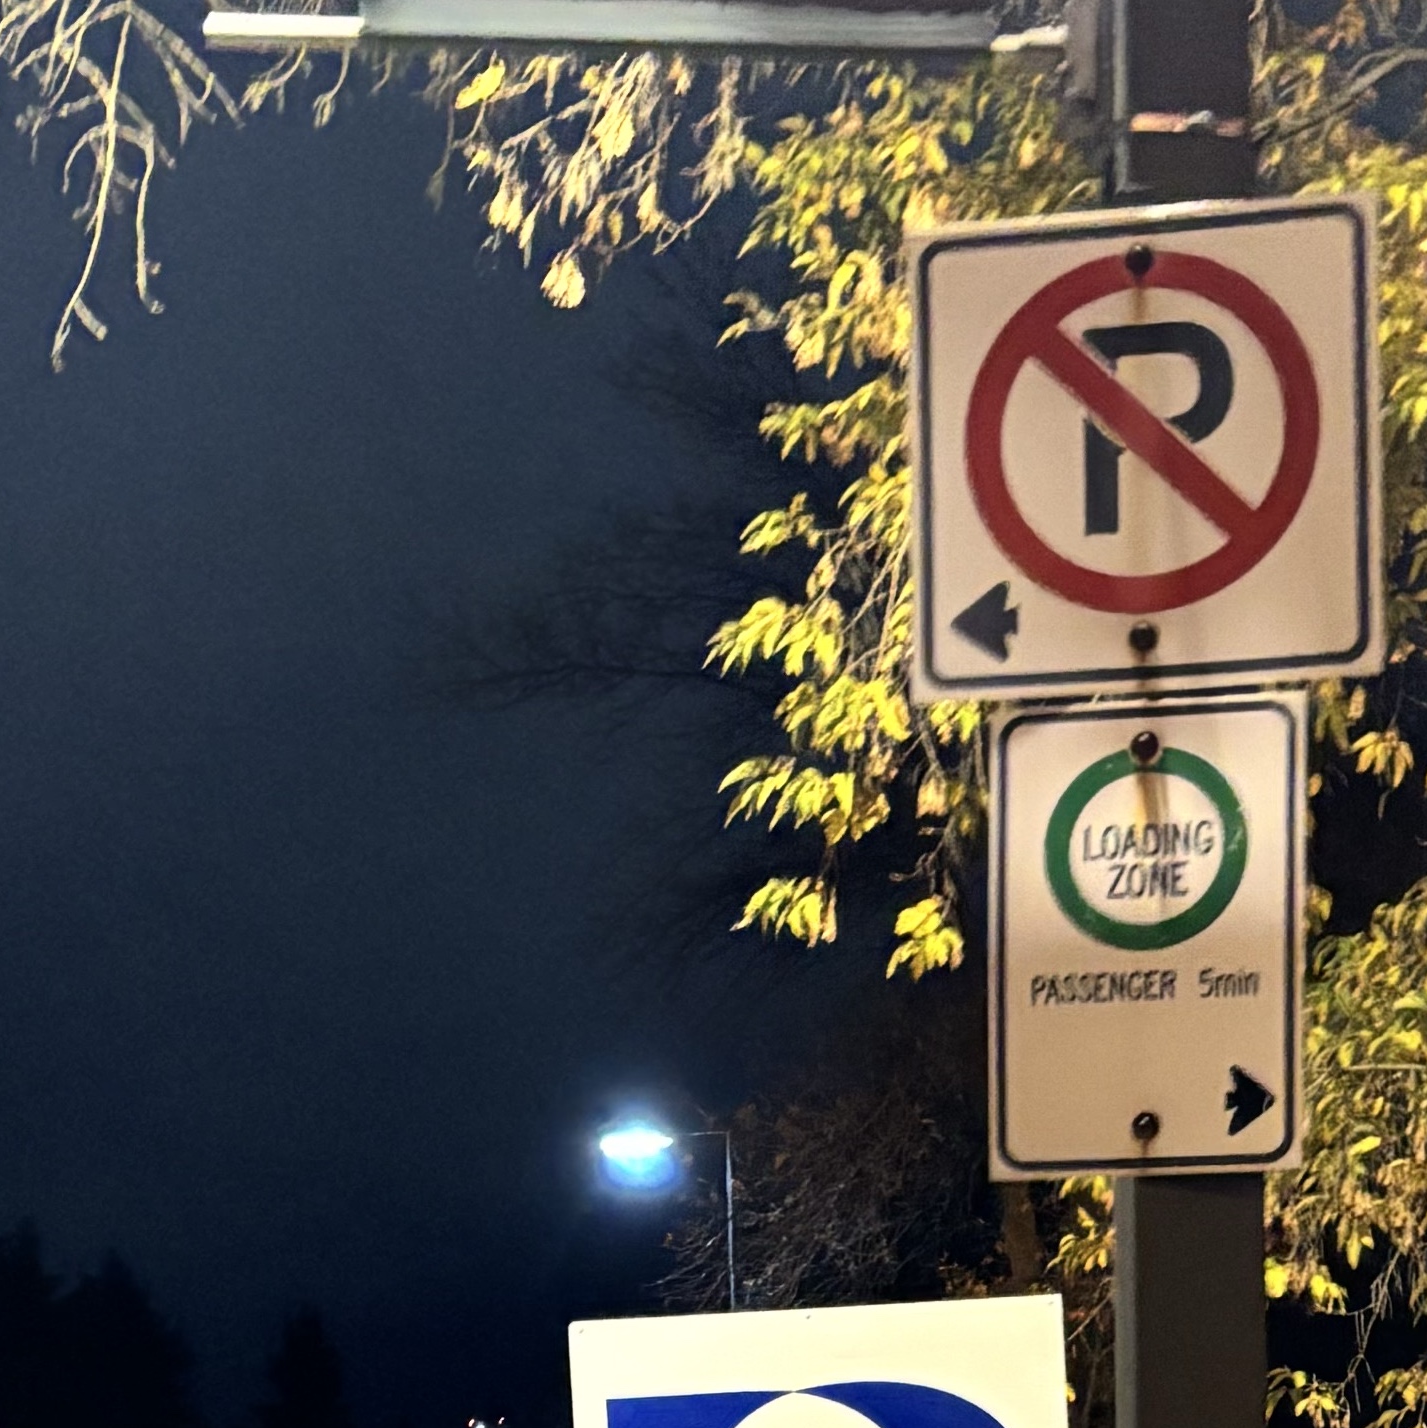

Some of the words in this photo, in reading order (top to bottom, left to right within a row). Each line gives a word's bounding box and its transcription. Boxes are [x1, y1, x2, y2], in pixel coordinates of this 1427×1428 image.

[1082, 321, 1234, 536] P
[1083, 820, 1215, 861] LOADING
[1107, 861, 1190, 899] ZONE
[1031, 970, 1177, 1006] PASSENGER
[1199, 968, 1260, 998] 5min
